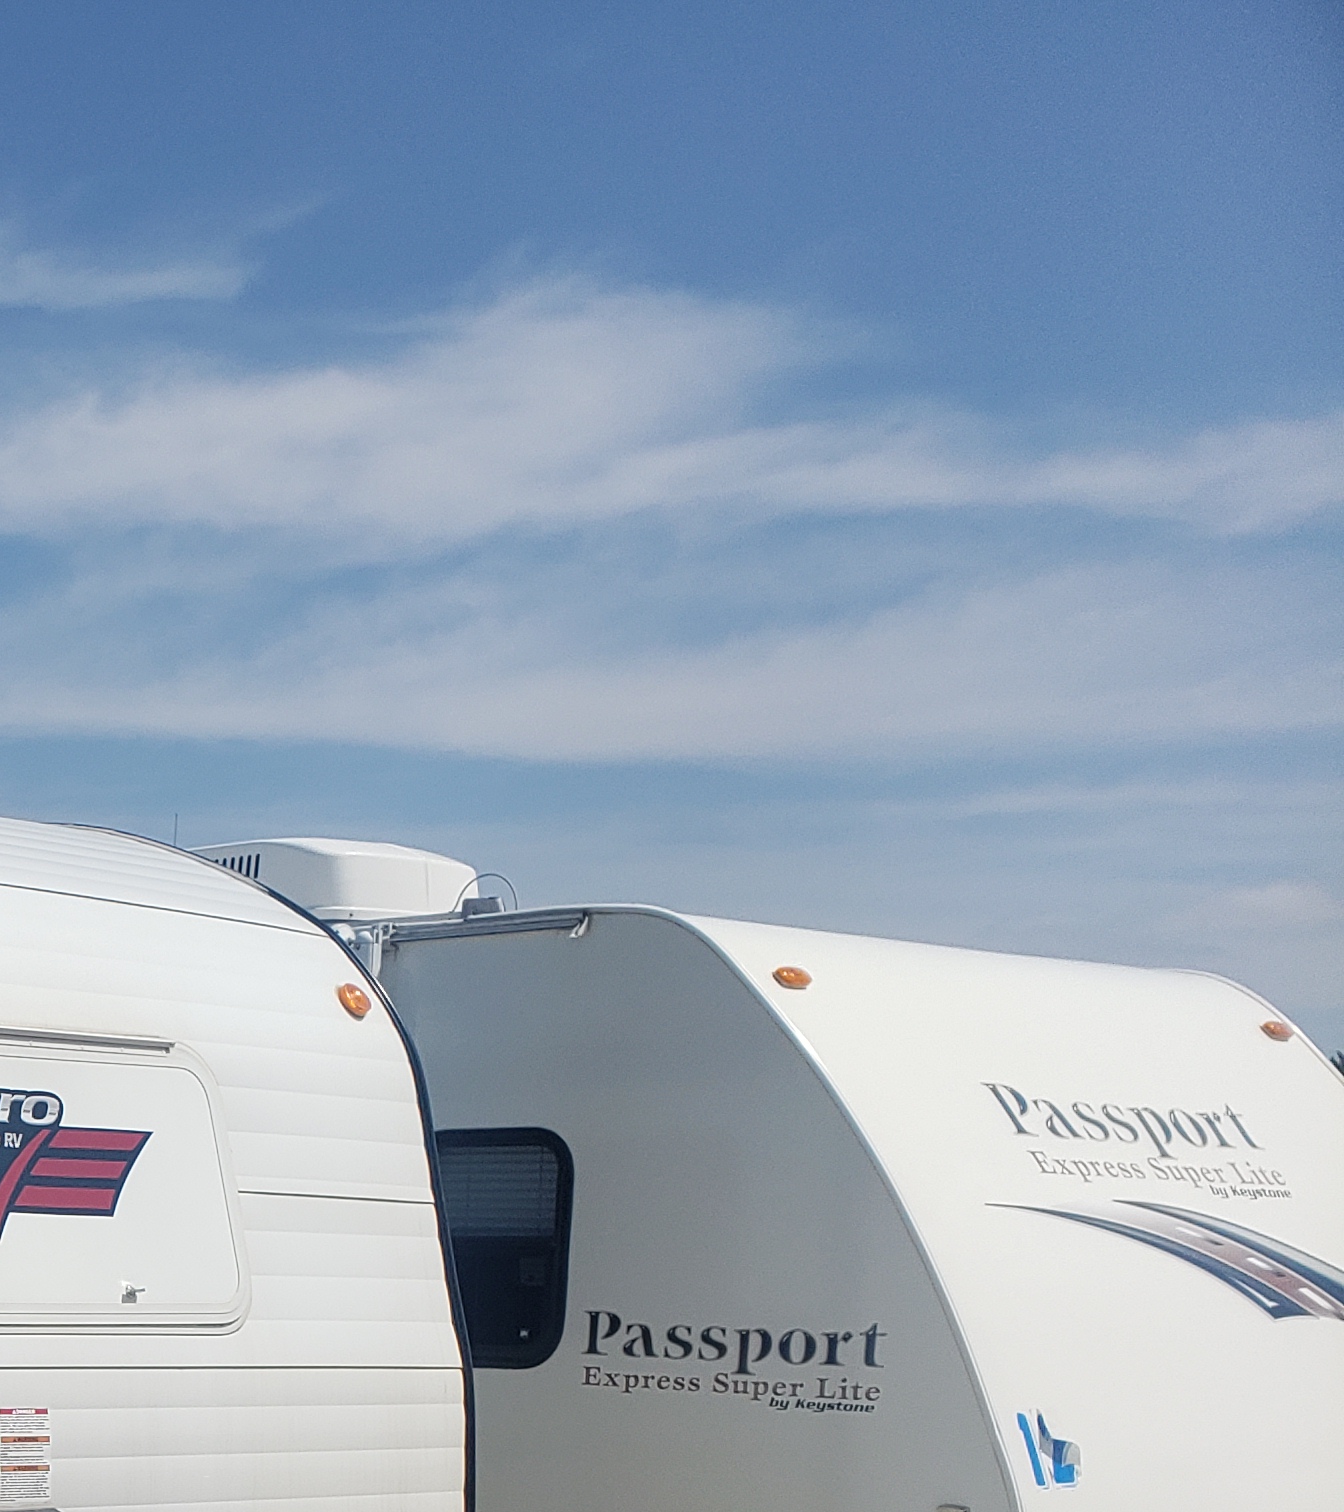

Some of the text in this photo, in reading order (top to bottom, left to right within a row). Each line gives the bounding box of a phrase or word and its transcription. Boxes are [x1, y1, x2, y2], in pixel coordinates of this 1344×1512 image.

[980, 1080, 1265, 1161] Passport
[3, 1132, 24, 1149] RV
[1026, 1149, 1288, 1188] Express Super Lite
[1208, 1183, 1293, 1200] by Keystone
[580, 1309, 889, 1377] Passport
[581, 1365, 881, 1402] Express Super Lite
[768, 1396, 876, 1414] by Keystone
